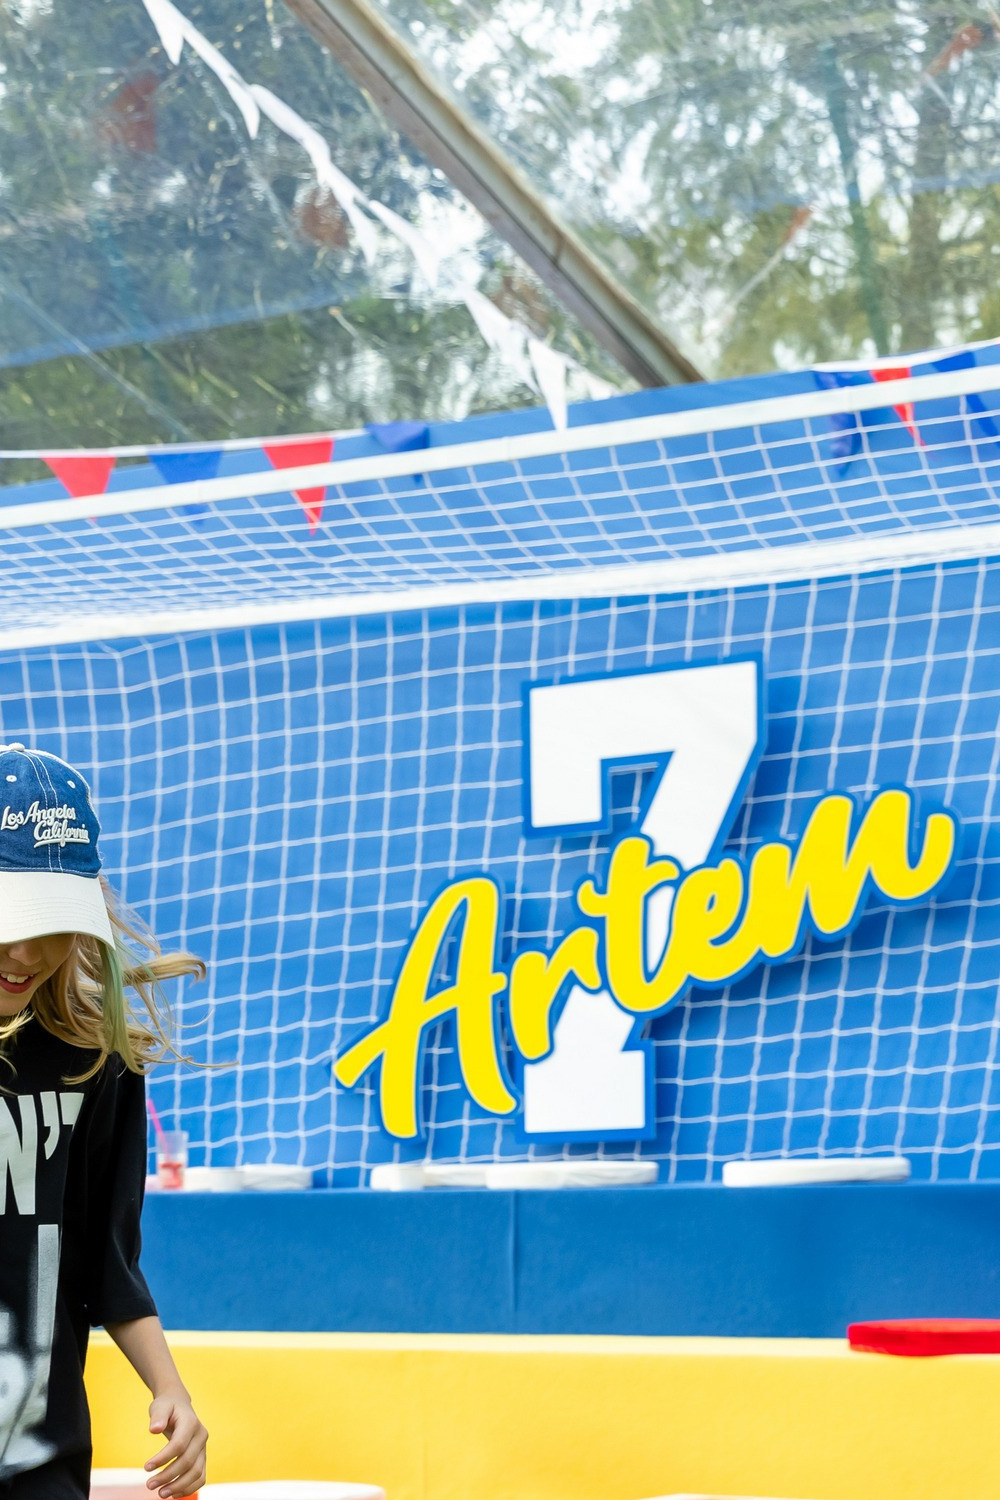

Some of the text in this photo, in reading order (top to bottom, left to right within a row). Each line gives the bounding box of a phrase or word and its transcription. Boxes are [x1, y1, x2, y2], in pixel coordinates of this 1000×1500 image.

[0, 800, 77, 831] Los Angeles
[33, 820, 90, 848] California
[524, 660, 759, 1133] 7
[332, 790, 956, 1138] Artem
